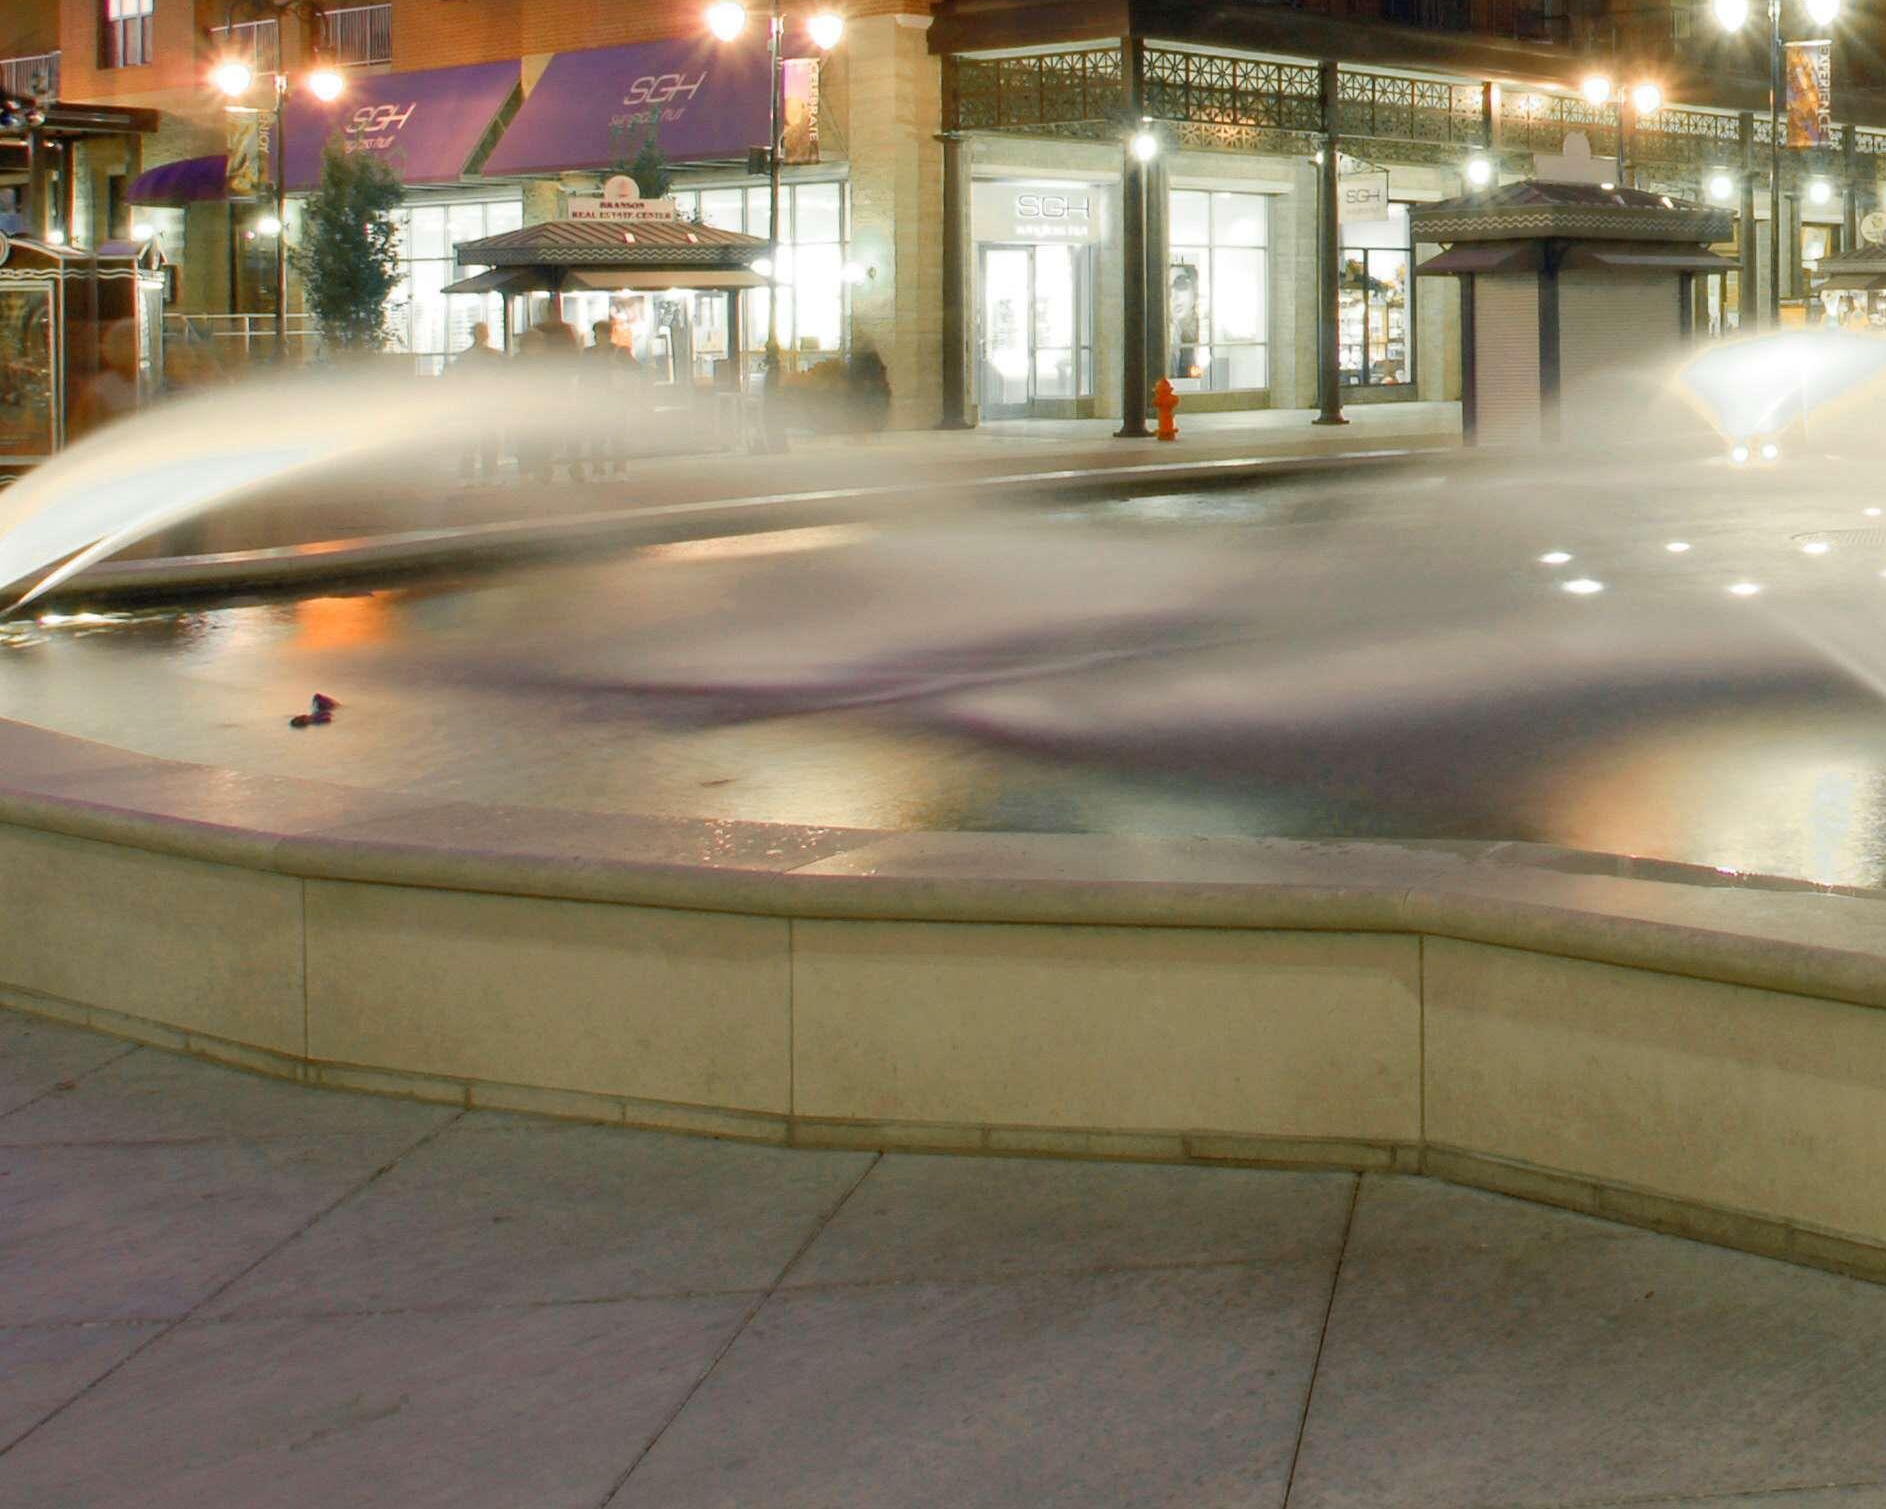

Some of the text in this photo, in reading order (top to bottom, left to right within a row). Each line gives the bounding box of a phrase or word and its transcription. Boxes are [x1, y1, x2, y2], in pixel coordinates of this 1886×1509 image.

[623, 71, 708, 105] SGH
[343, 101, 417, 133] SGH
[600, 201, 645, 209] BRANSON
[1346, 188, 1380, 204] SGH
[572, 211, 671, 220] REAL ESTATE CENTER
[1018, 194, 1090, 219] SGH
